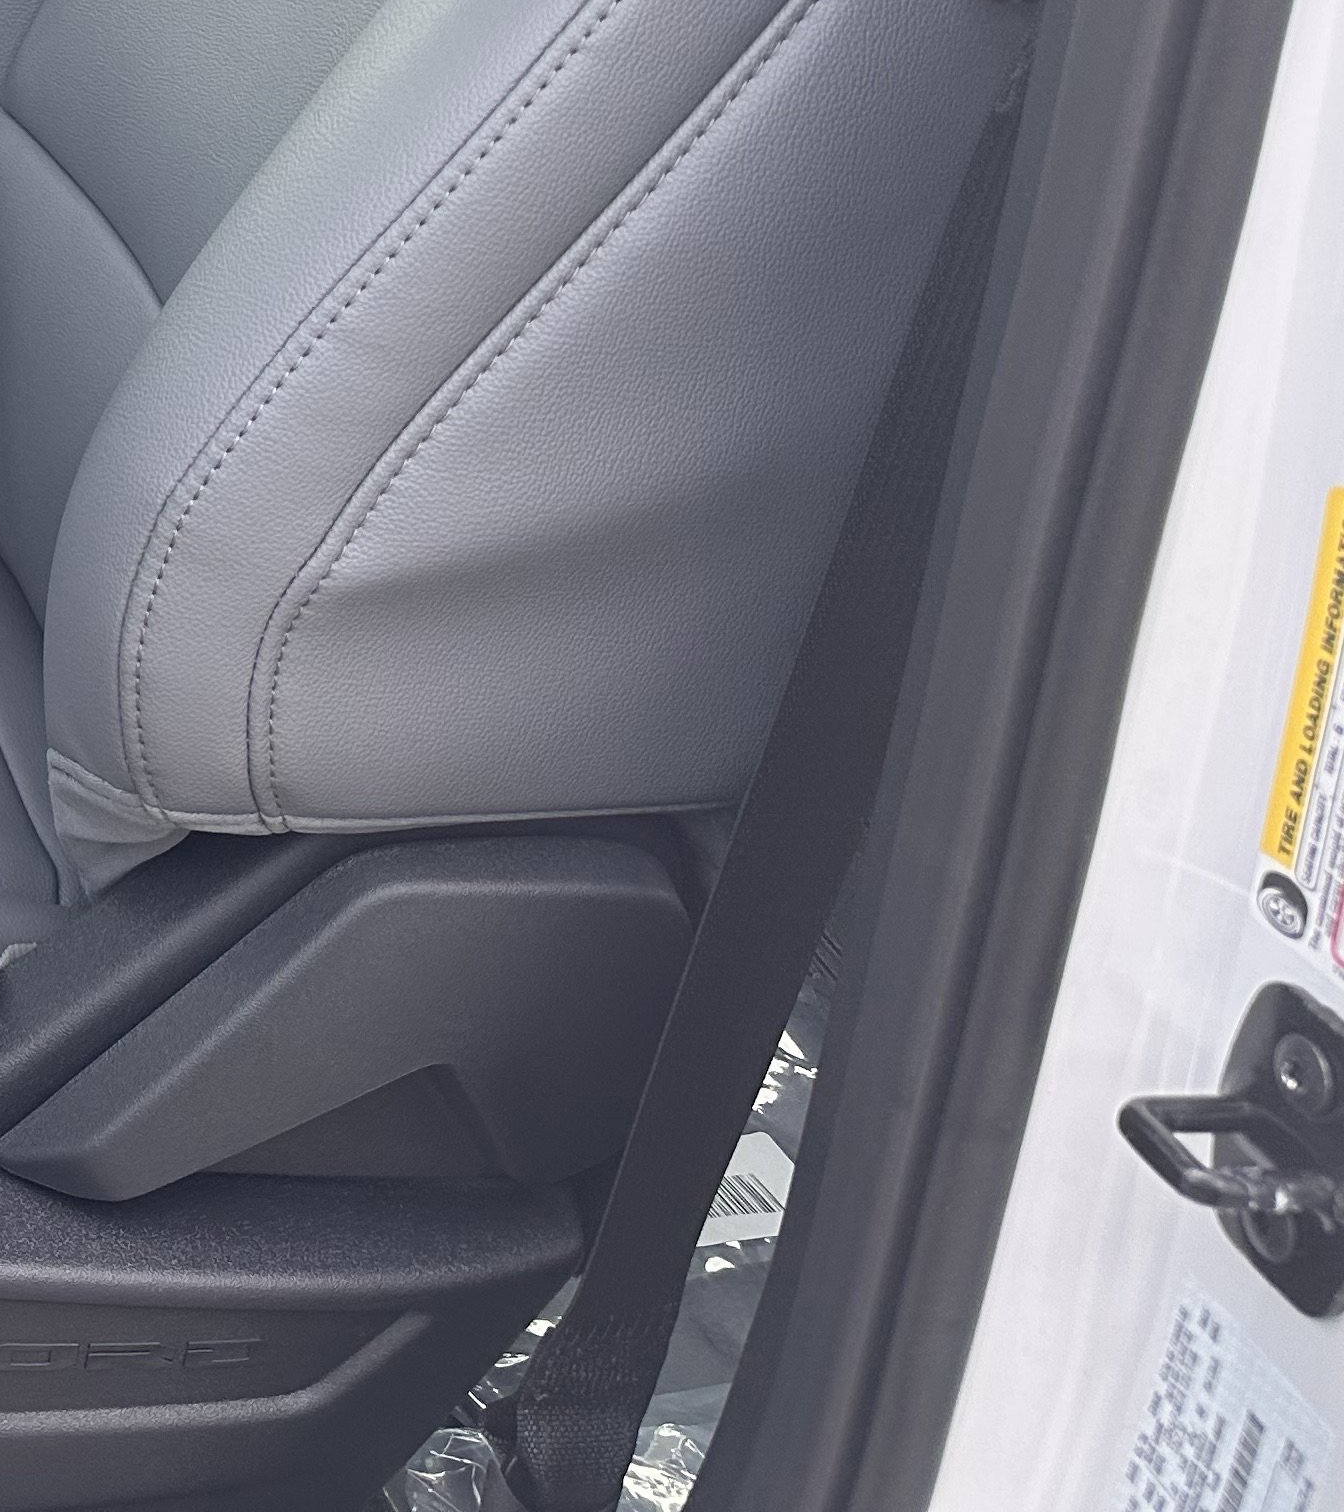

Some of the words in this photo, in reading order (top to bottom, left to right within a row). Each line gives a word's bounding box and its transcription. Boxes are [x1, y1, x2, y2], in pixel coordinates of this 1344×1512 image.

[1278, 805, 1298, 856] TIRE
[1290, 758, 1308, 806] AND
[1299, 658, 1331, 756] LOADING
